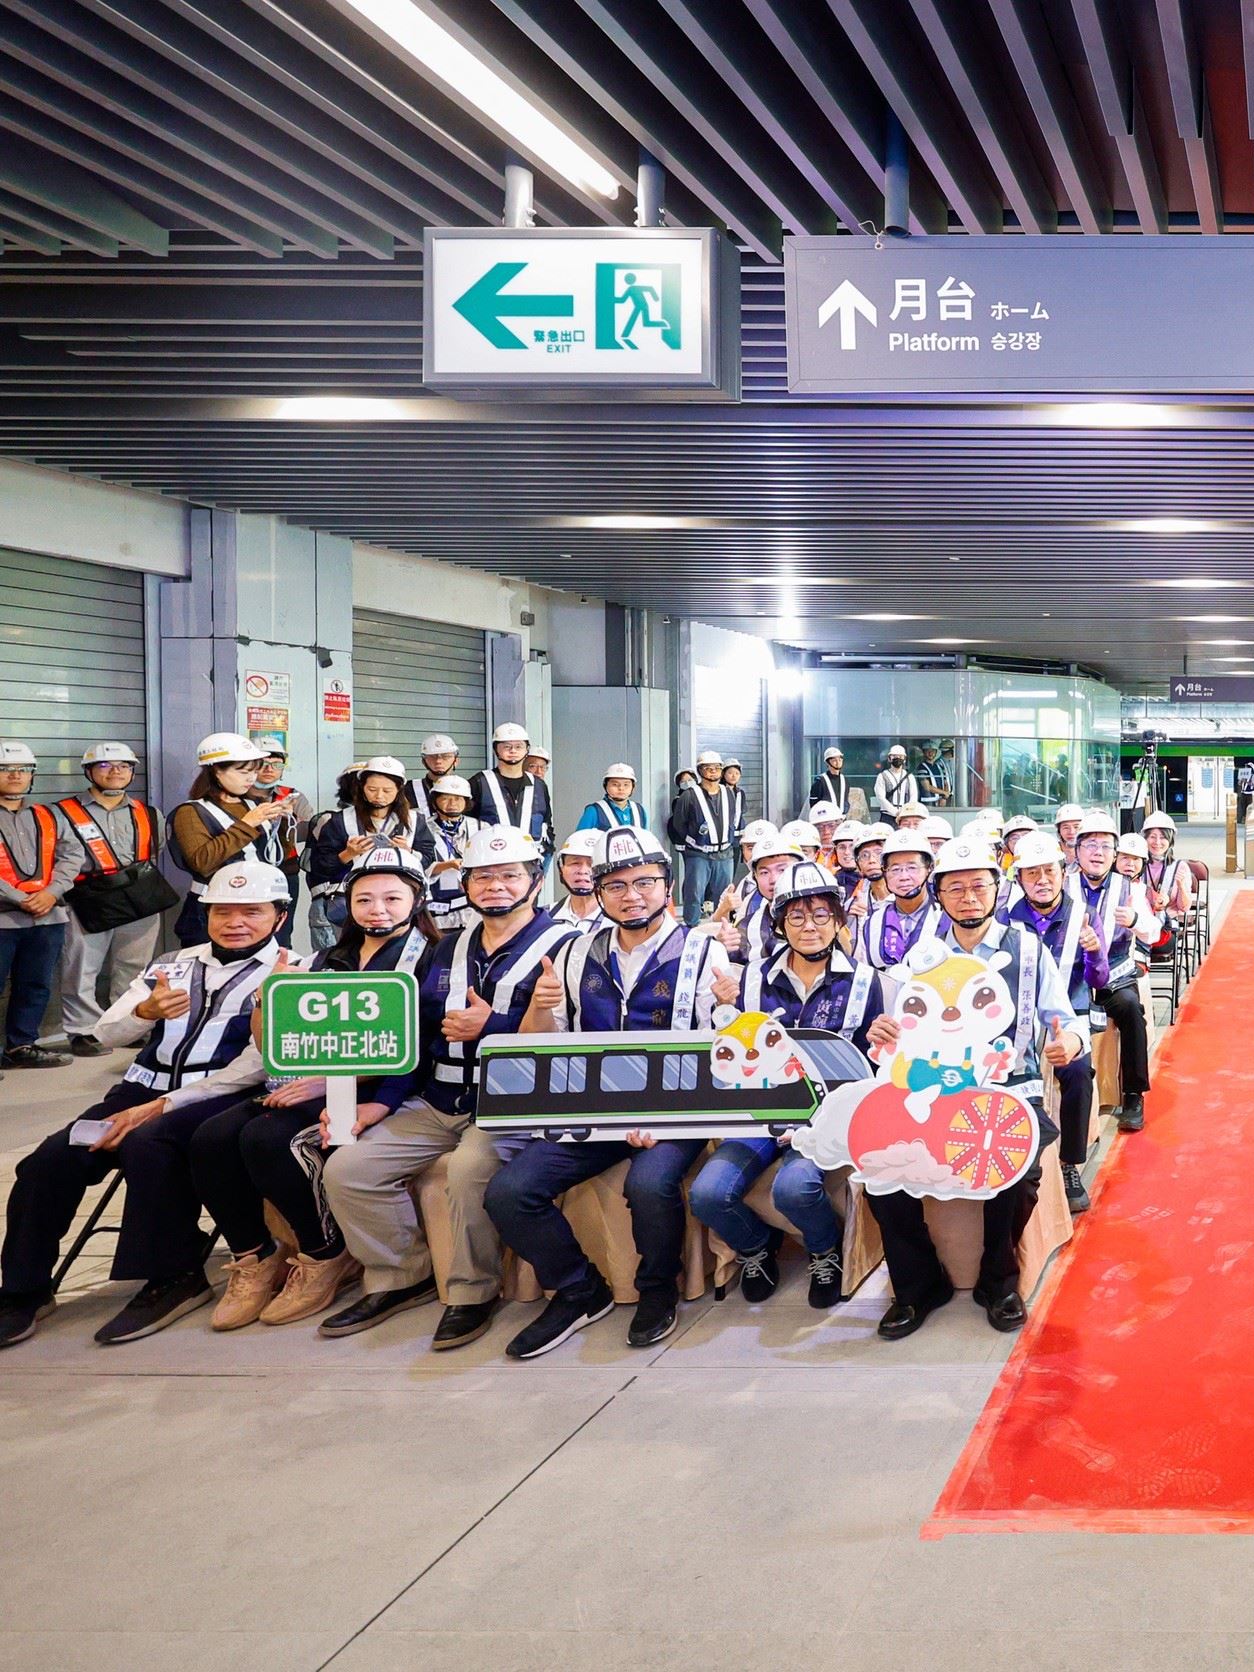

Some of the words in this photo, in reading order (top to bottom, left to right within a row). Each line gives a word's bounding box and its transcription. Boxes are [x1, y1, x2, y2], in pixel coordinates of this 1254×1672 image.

[888, 276, 977, 321] 月台
[990, 301, 1050, 321] ホーム
[533, 330, 585, 342] 緊急出口
[546, 344, 571, 353] EXIT
[888, 332, 981, 351] Platform
[991, 331, 1043, 351] 승강장
[298, 990, 381, 1022] G13
[280, 1030, 399, 1060] 南竹中正北站
